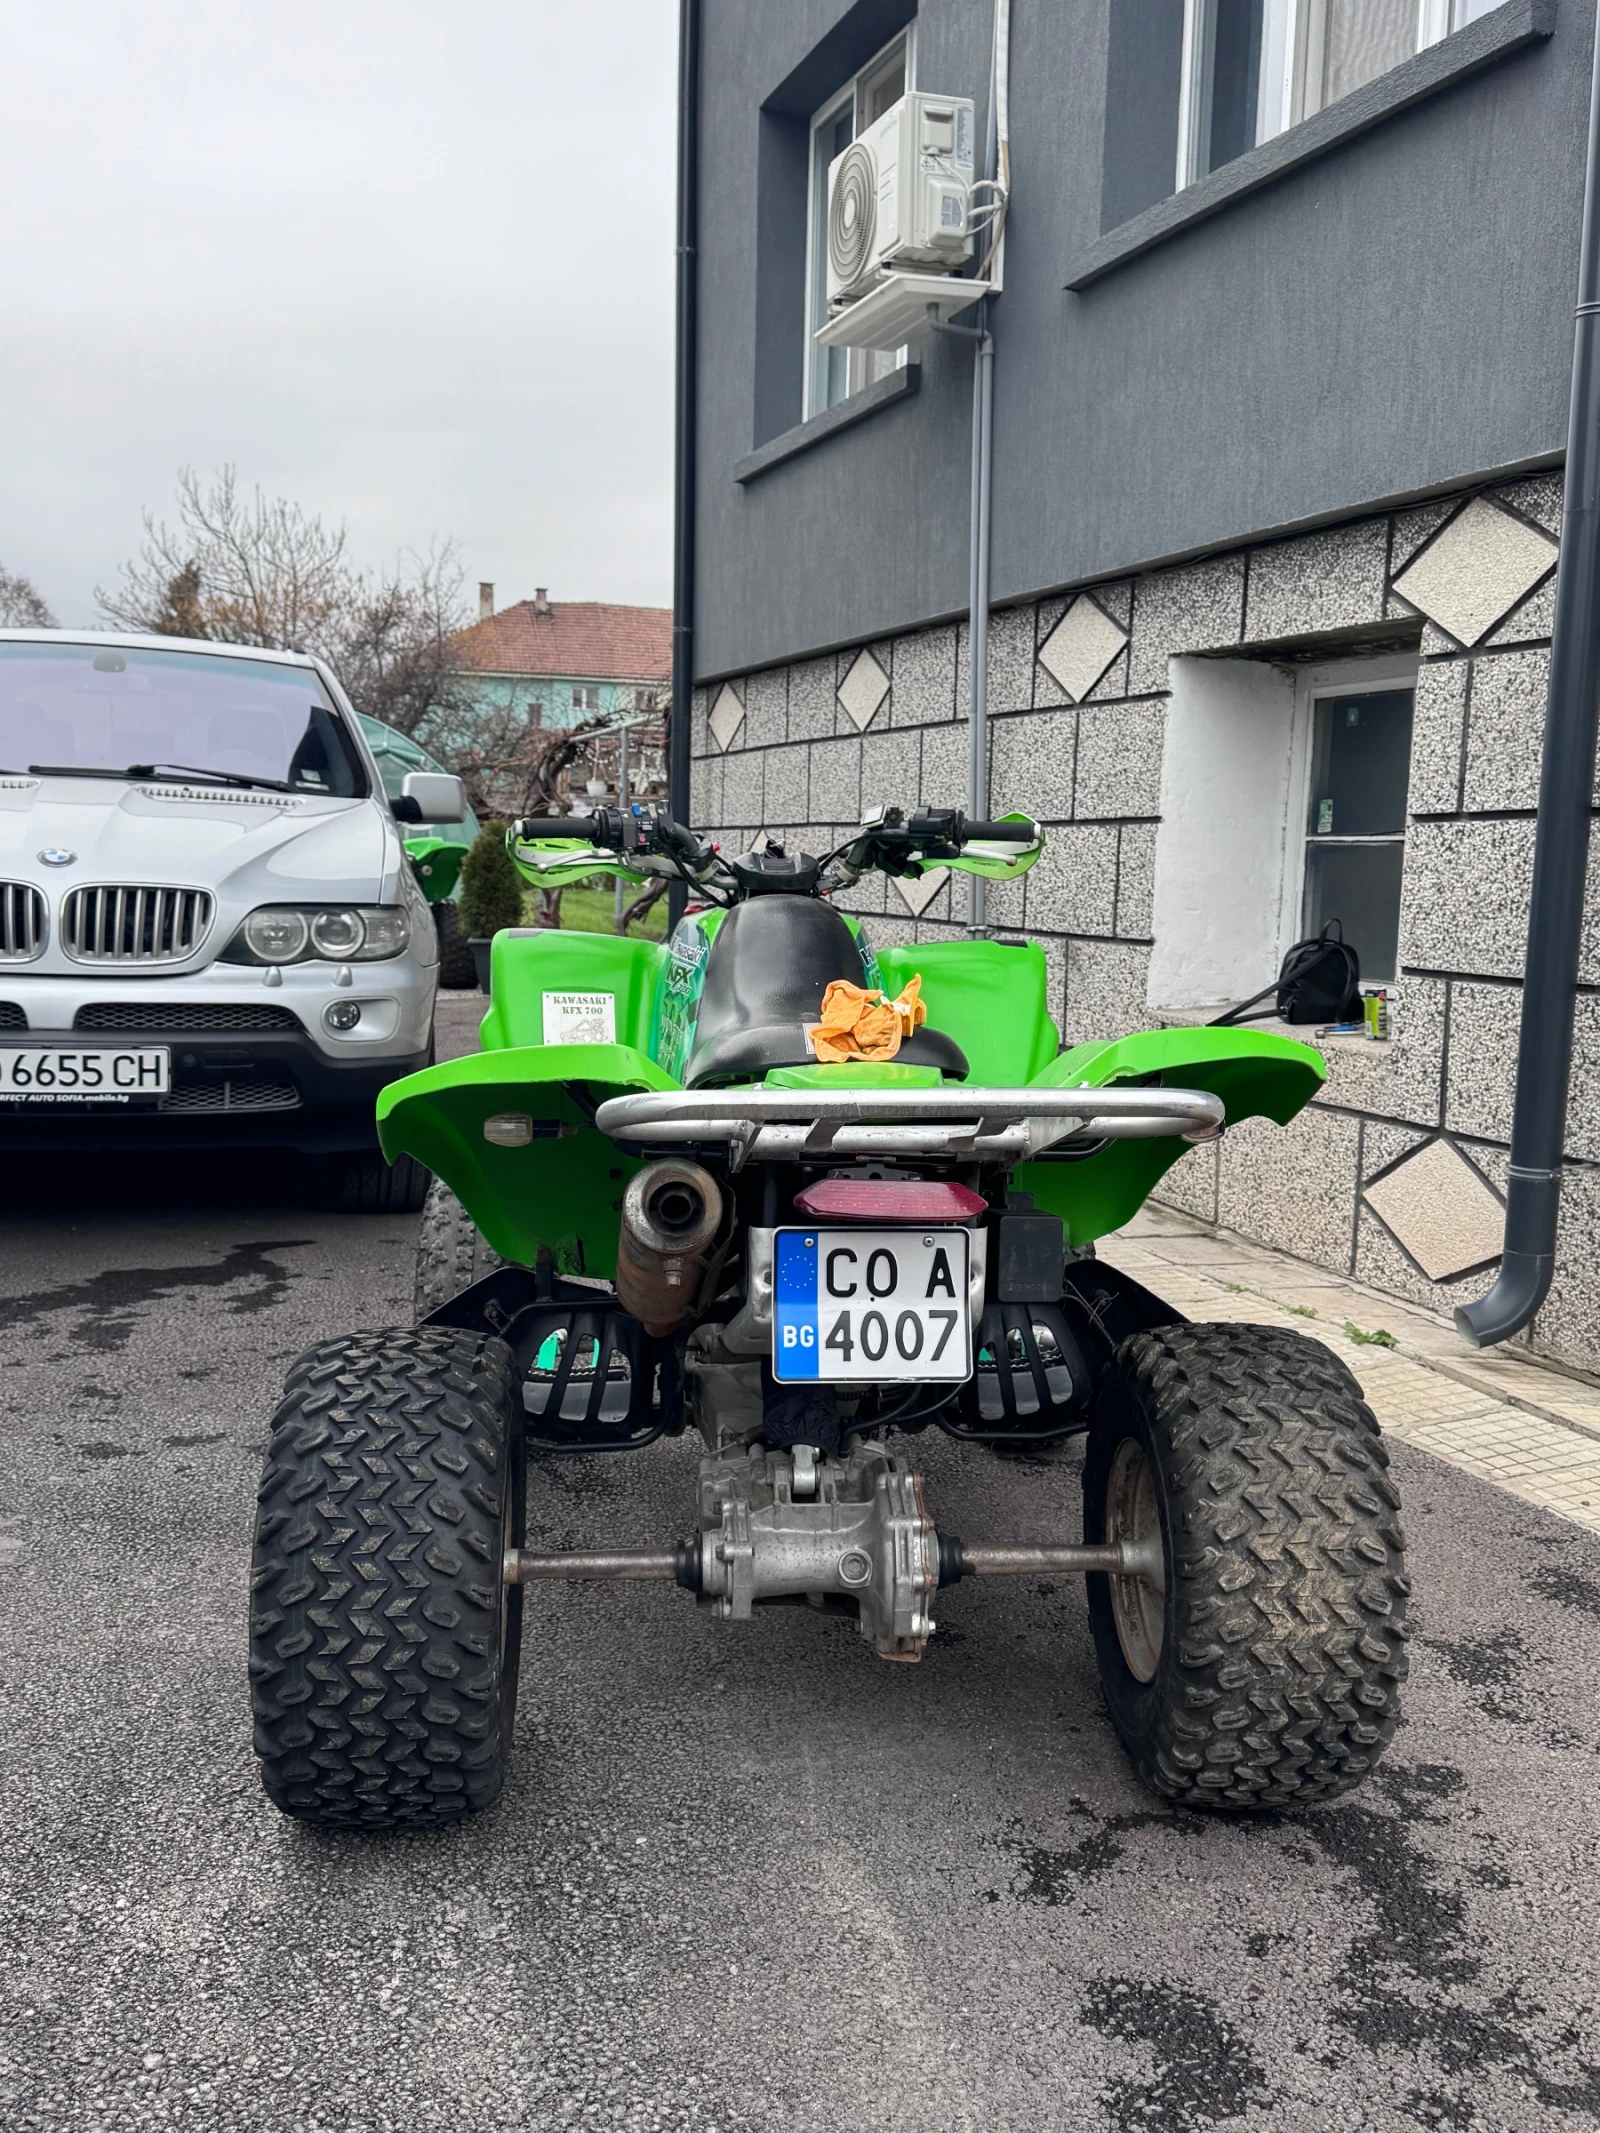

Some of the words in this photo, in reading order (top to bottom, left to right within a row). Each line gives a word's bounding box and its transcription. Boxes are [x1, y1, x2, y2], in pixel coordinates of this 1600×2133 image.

[553, 996, 606, 1005] KAWASAKI
[562, 1006, 582, 1015] KFX
[585, 1006, 603, 1015] 700
[12, 1054, 103, 1087] 6655
[113, 1055, 160, 1087] CH
[28, 1093, 55, 1102] AUTO
[56, 1093, 129, 1103] SOFIA.mobile.bg
[826, 1247, 898, 1298] CO
[925, 1247, 956, 1298] A
[783, 1325, 814, 1348] BG
[825, 1309, 958, 1362] 4007
